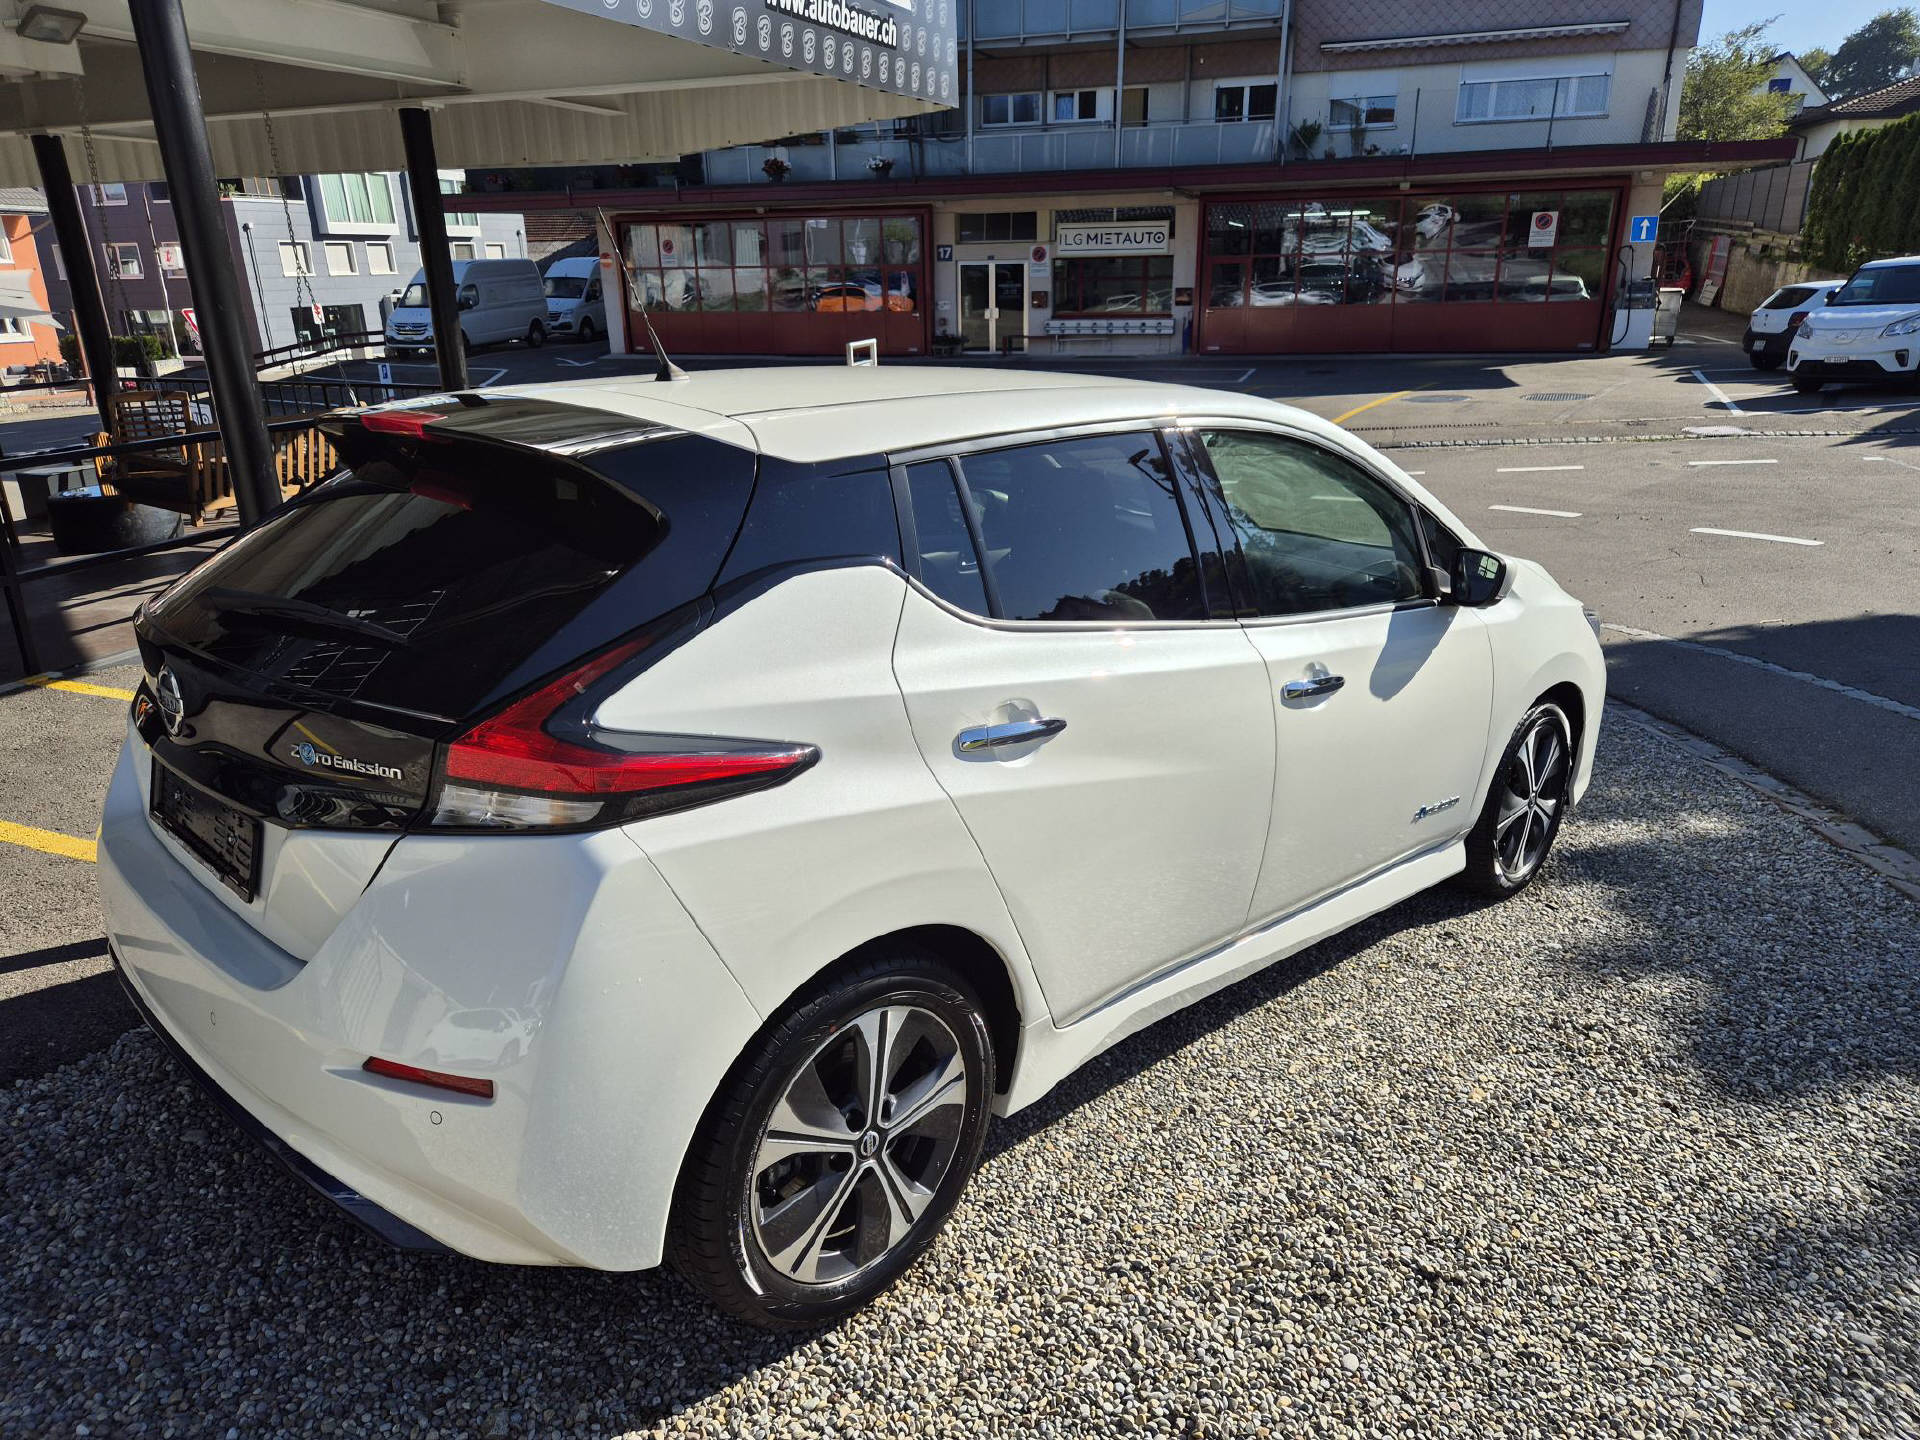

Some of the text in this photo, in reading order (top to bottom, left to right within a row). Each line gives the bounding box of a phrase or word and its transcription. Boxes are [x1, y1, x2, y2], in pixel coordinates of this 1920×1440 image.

[766, 0, 897, 47] w.autobauer.ch
[1059, 231, 1166, 246] ILG MIETAUTO
[938, 247, 952, 259] 17
[290, 742, 402, 780] Zro Emission
